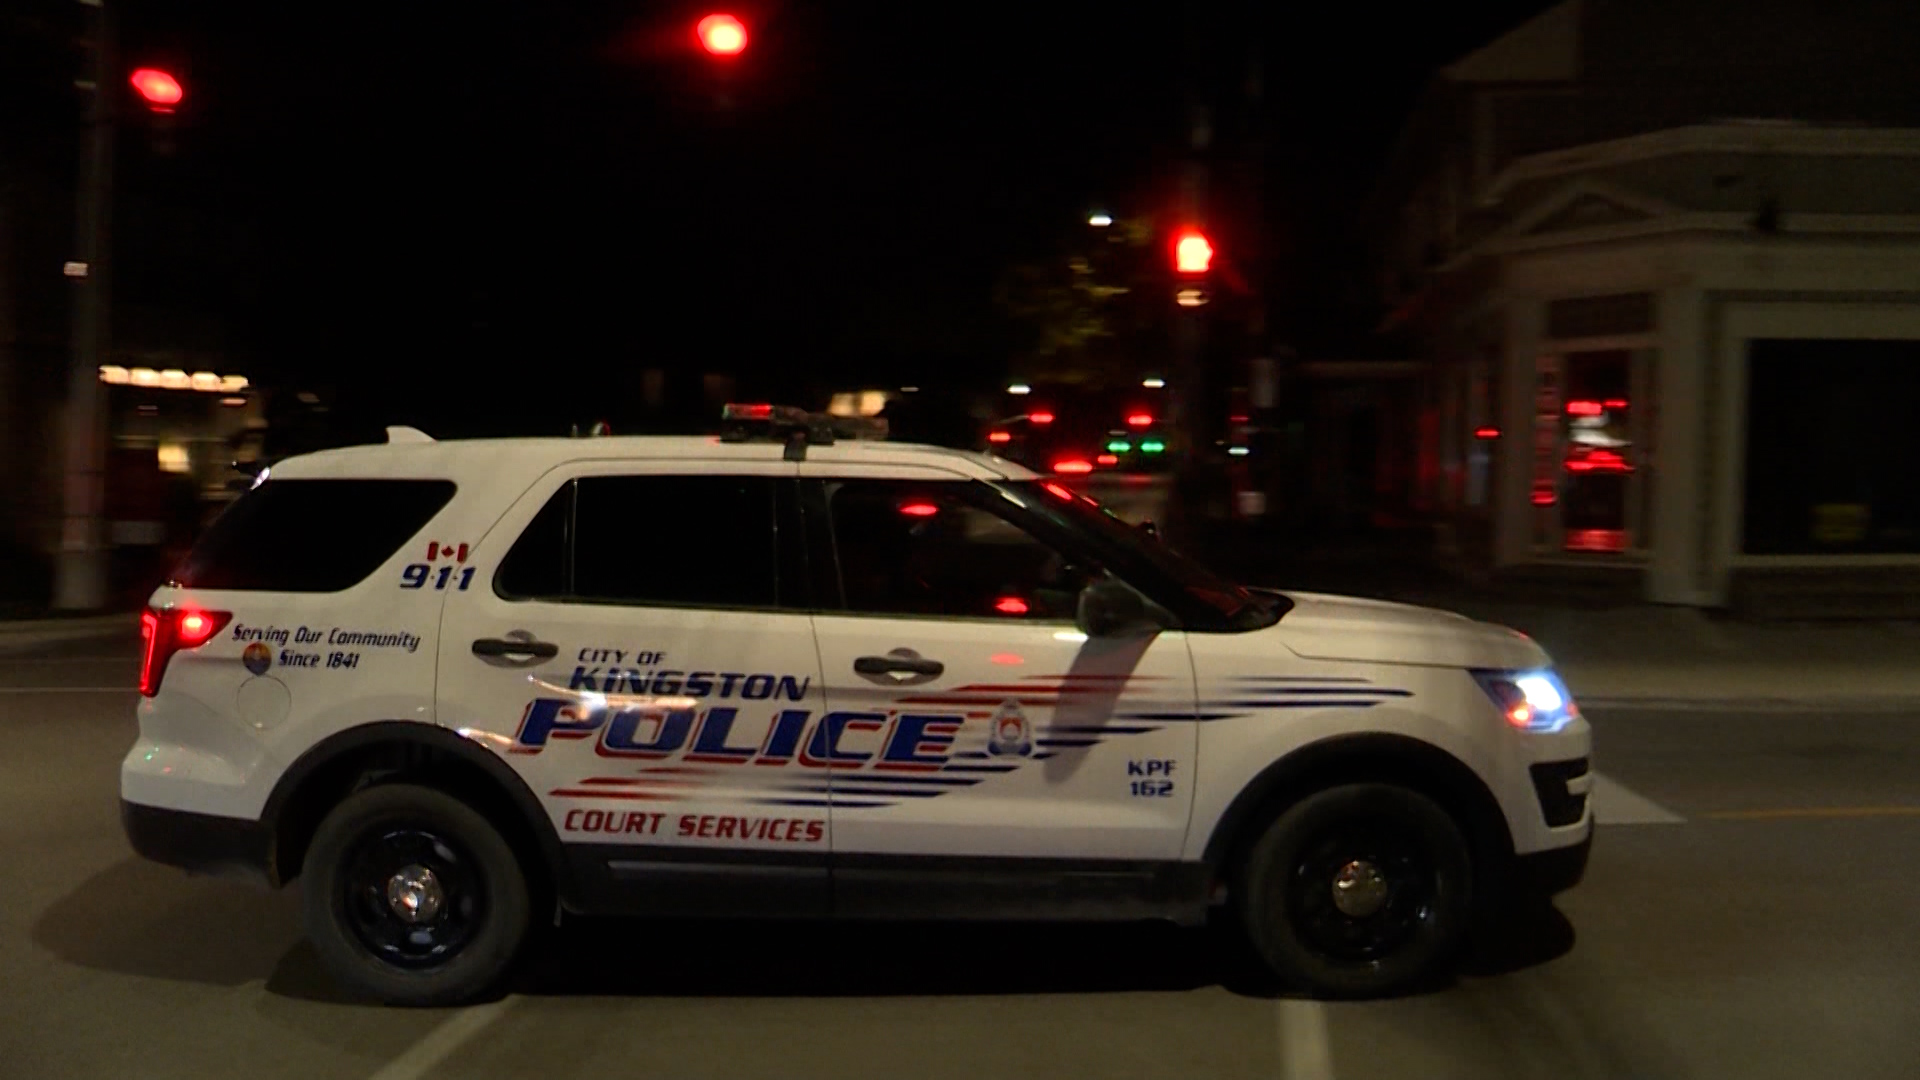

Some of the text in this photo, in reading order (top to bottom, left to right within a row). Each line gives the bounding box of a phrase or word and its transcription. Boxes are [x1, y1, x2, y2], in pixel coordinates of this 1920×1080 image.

[231, 623, 421, 653] Serving Our Community
[278, 649, 360, 669] Since 1841
[577, 647, 667, 664] CITY OF
[568, 666, 810, 701] KINGSTON
[508, 697, 966, 771] POLICE
[1127, 759, 1178, 776] KPF
[564, 809, 825, 842] COURT SERVICES
